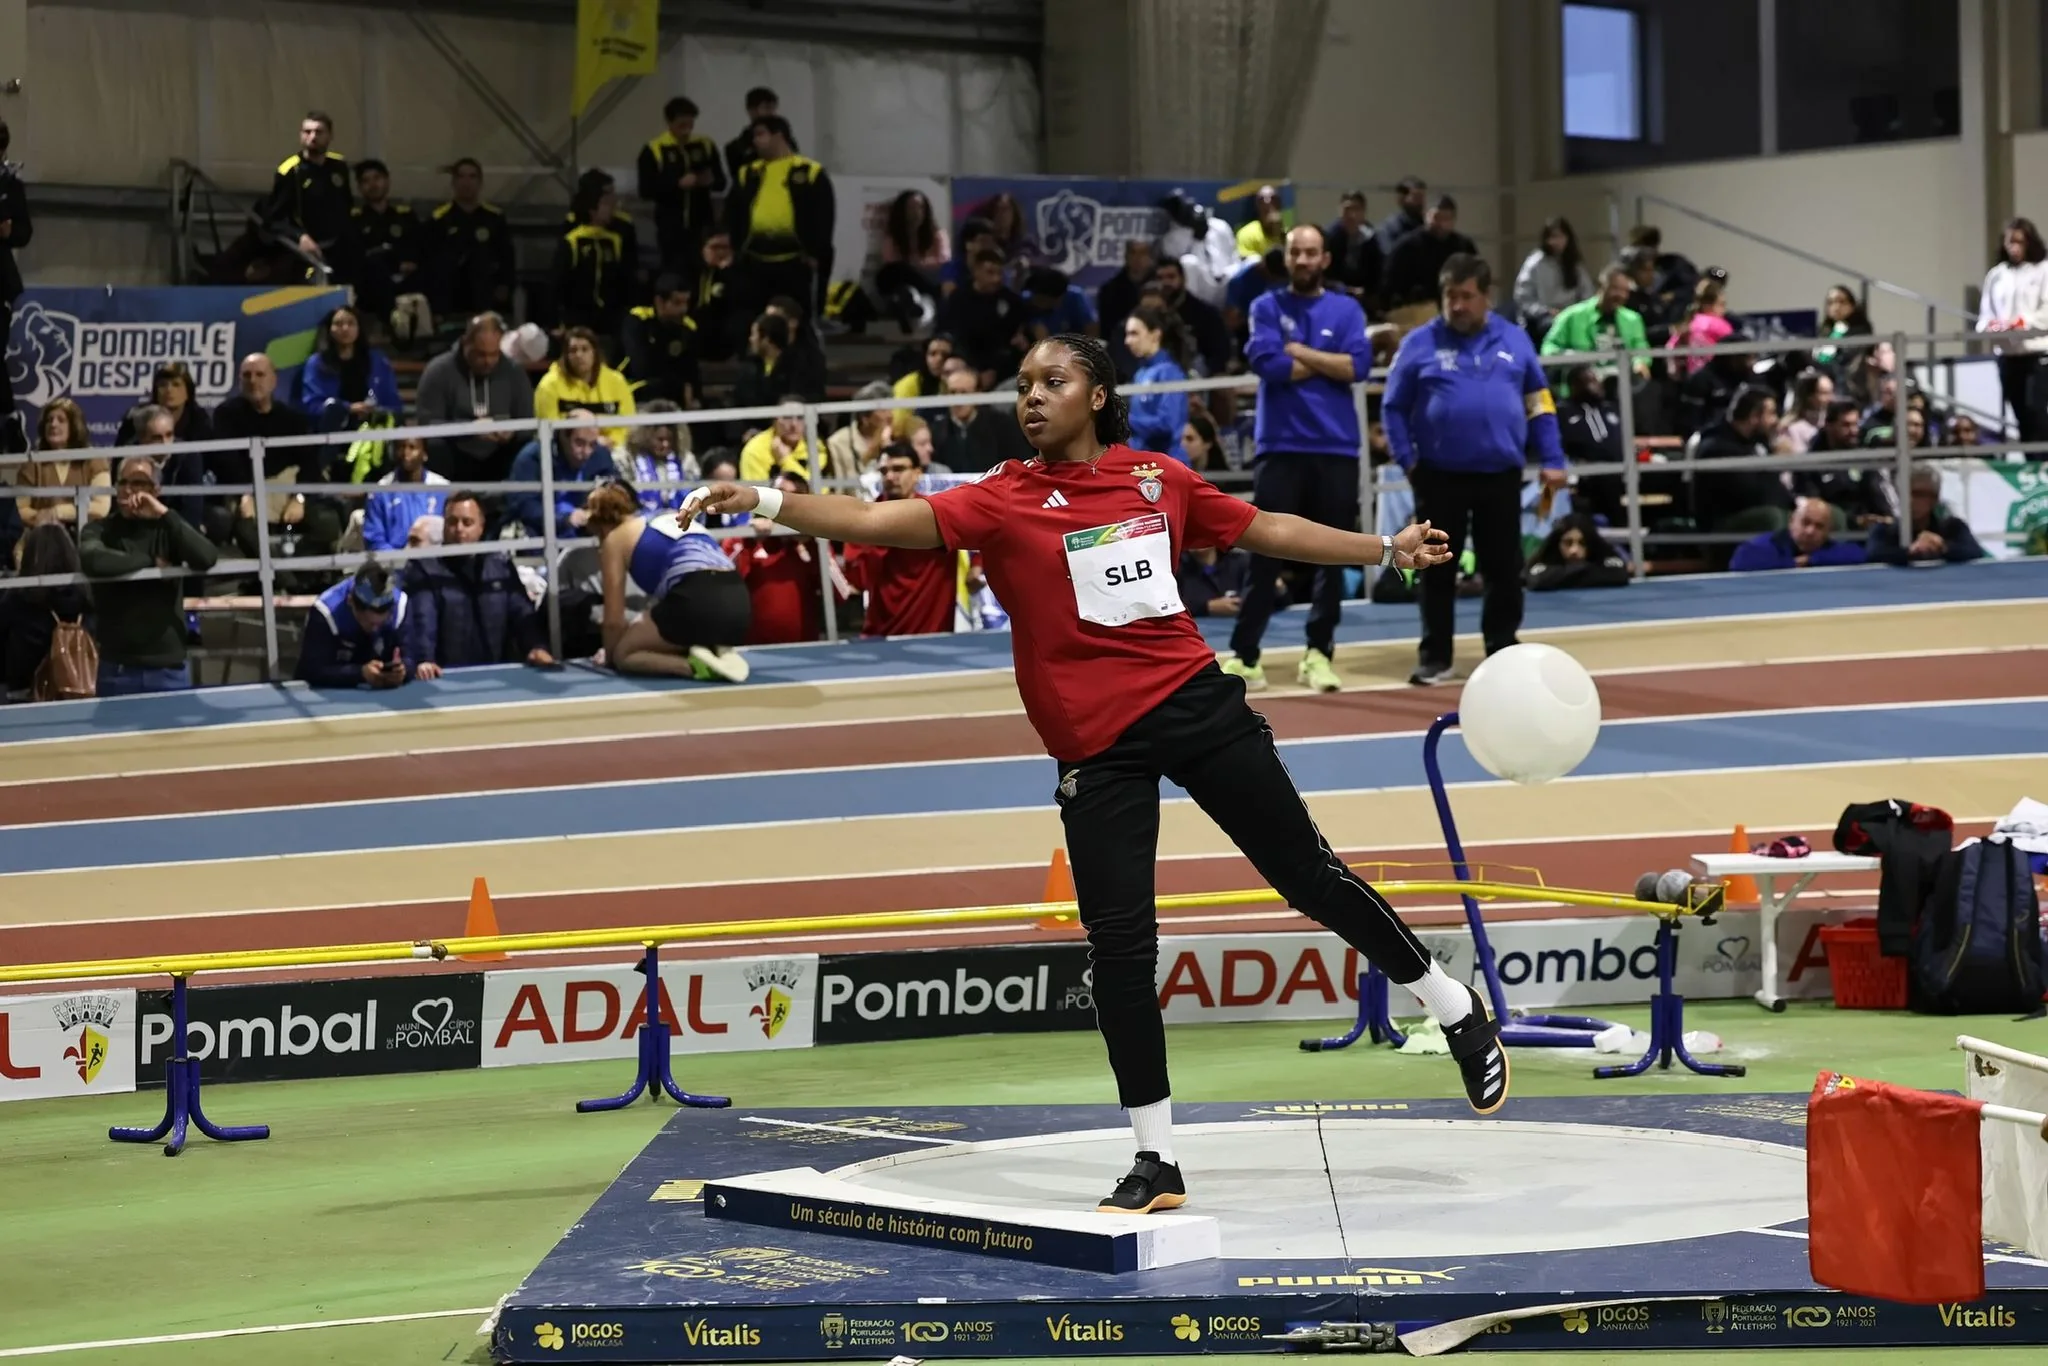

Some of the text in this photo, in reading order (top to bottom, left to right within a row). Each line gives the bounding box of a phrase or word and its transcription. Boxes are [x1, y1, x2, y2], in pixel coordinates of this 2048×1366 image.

[81, 329, 201, 357] POMBAL
[79, 361, 227, 388] DESPTO
[1105, 559, 1152, 586] SLB
[822, 965, 1049, 1023] Pombal
[494, 974, 728, 1049] ADAL
[140, 999, 377, 1065] Pombal
[395, 1028, 474, 1049] POMBAL
[790, 1202, 1033, 1251] Um século de história com futuro
[1597, 1306, 1650, 1327] JOGOS
[1782, 1306, 1832, 1327] 100
[1836, 1306, 1877, 1318] ANOS
[1937, 1302, 2017, 1328] Vitalis
[571, 1322, 624, 1343] JOGOS
[683, 1317, 761, 1346] Vitalis
[899, 1321, 949, 1343] 100
[953, 1321, 994, 1333] ANOS
[1045, 1312, 1124, 1342] Vitalis
[1207, 1316, 1261, 1336] JOGOS
